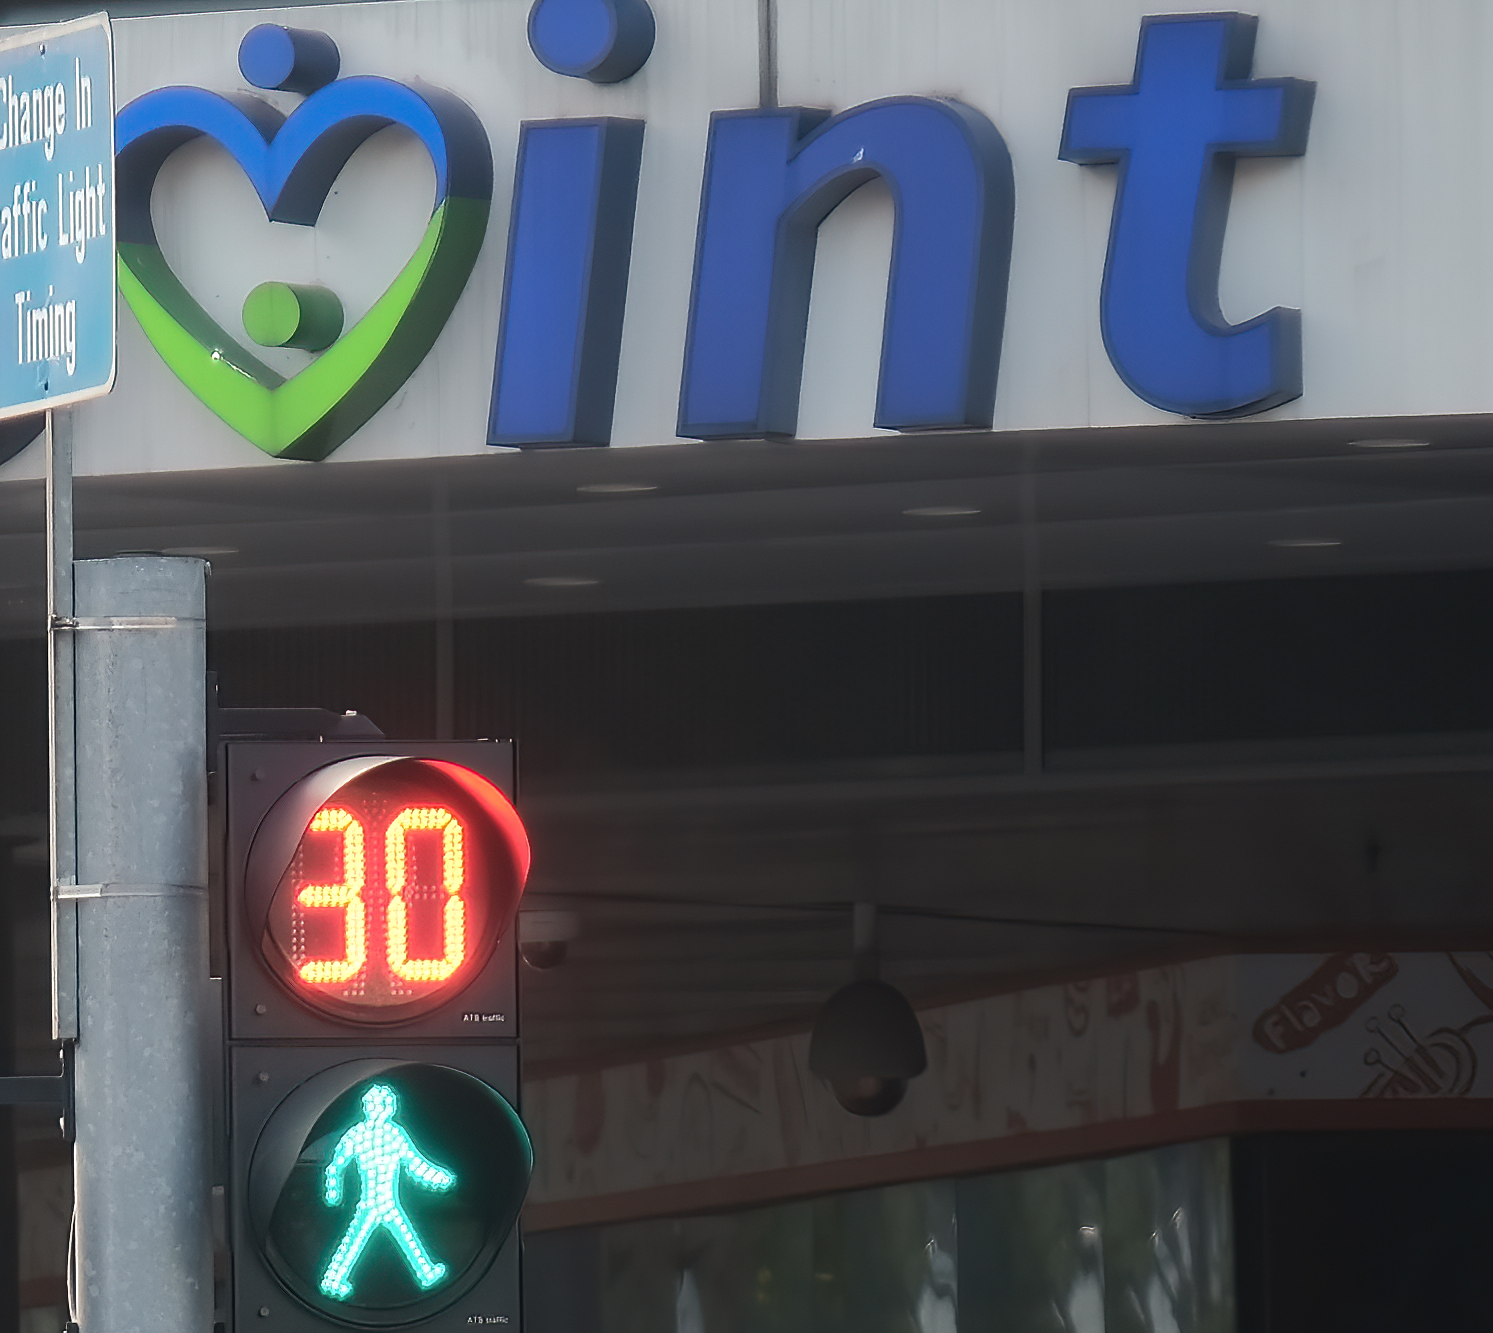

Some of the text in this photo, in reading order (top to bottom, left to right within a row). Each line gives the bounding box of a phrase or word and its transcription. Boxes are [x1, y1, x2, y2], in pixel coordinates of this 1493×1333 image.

[74, 57, 94, 131] In
[57, 163, 107, 265] Light
[14, 285, 77, 377] Timing
[295, 806, 466, 984] 30
